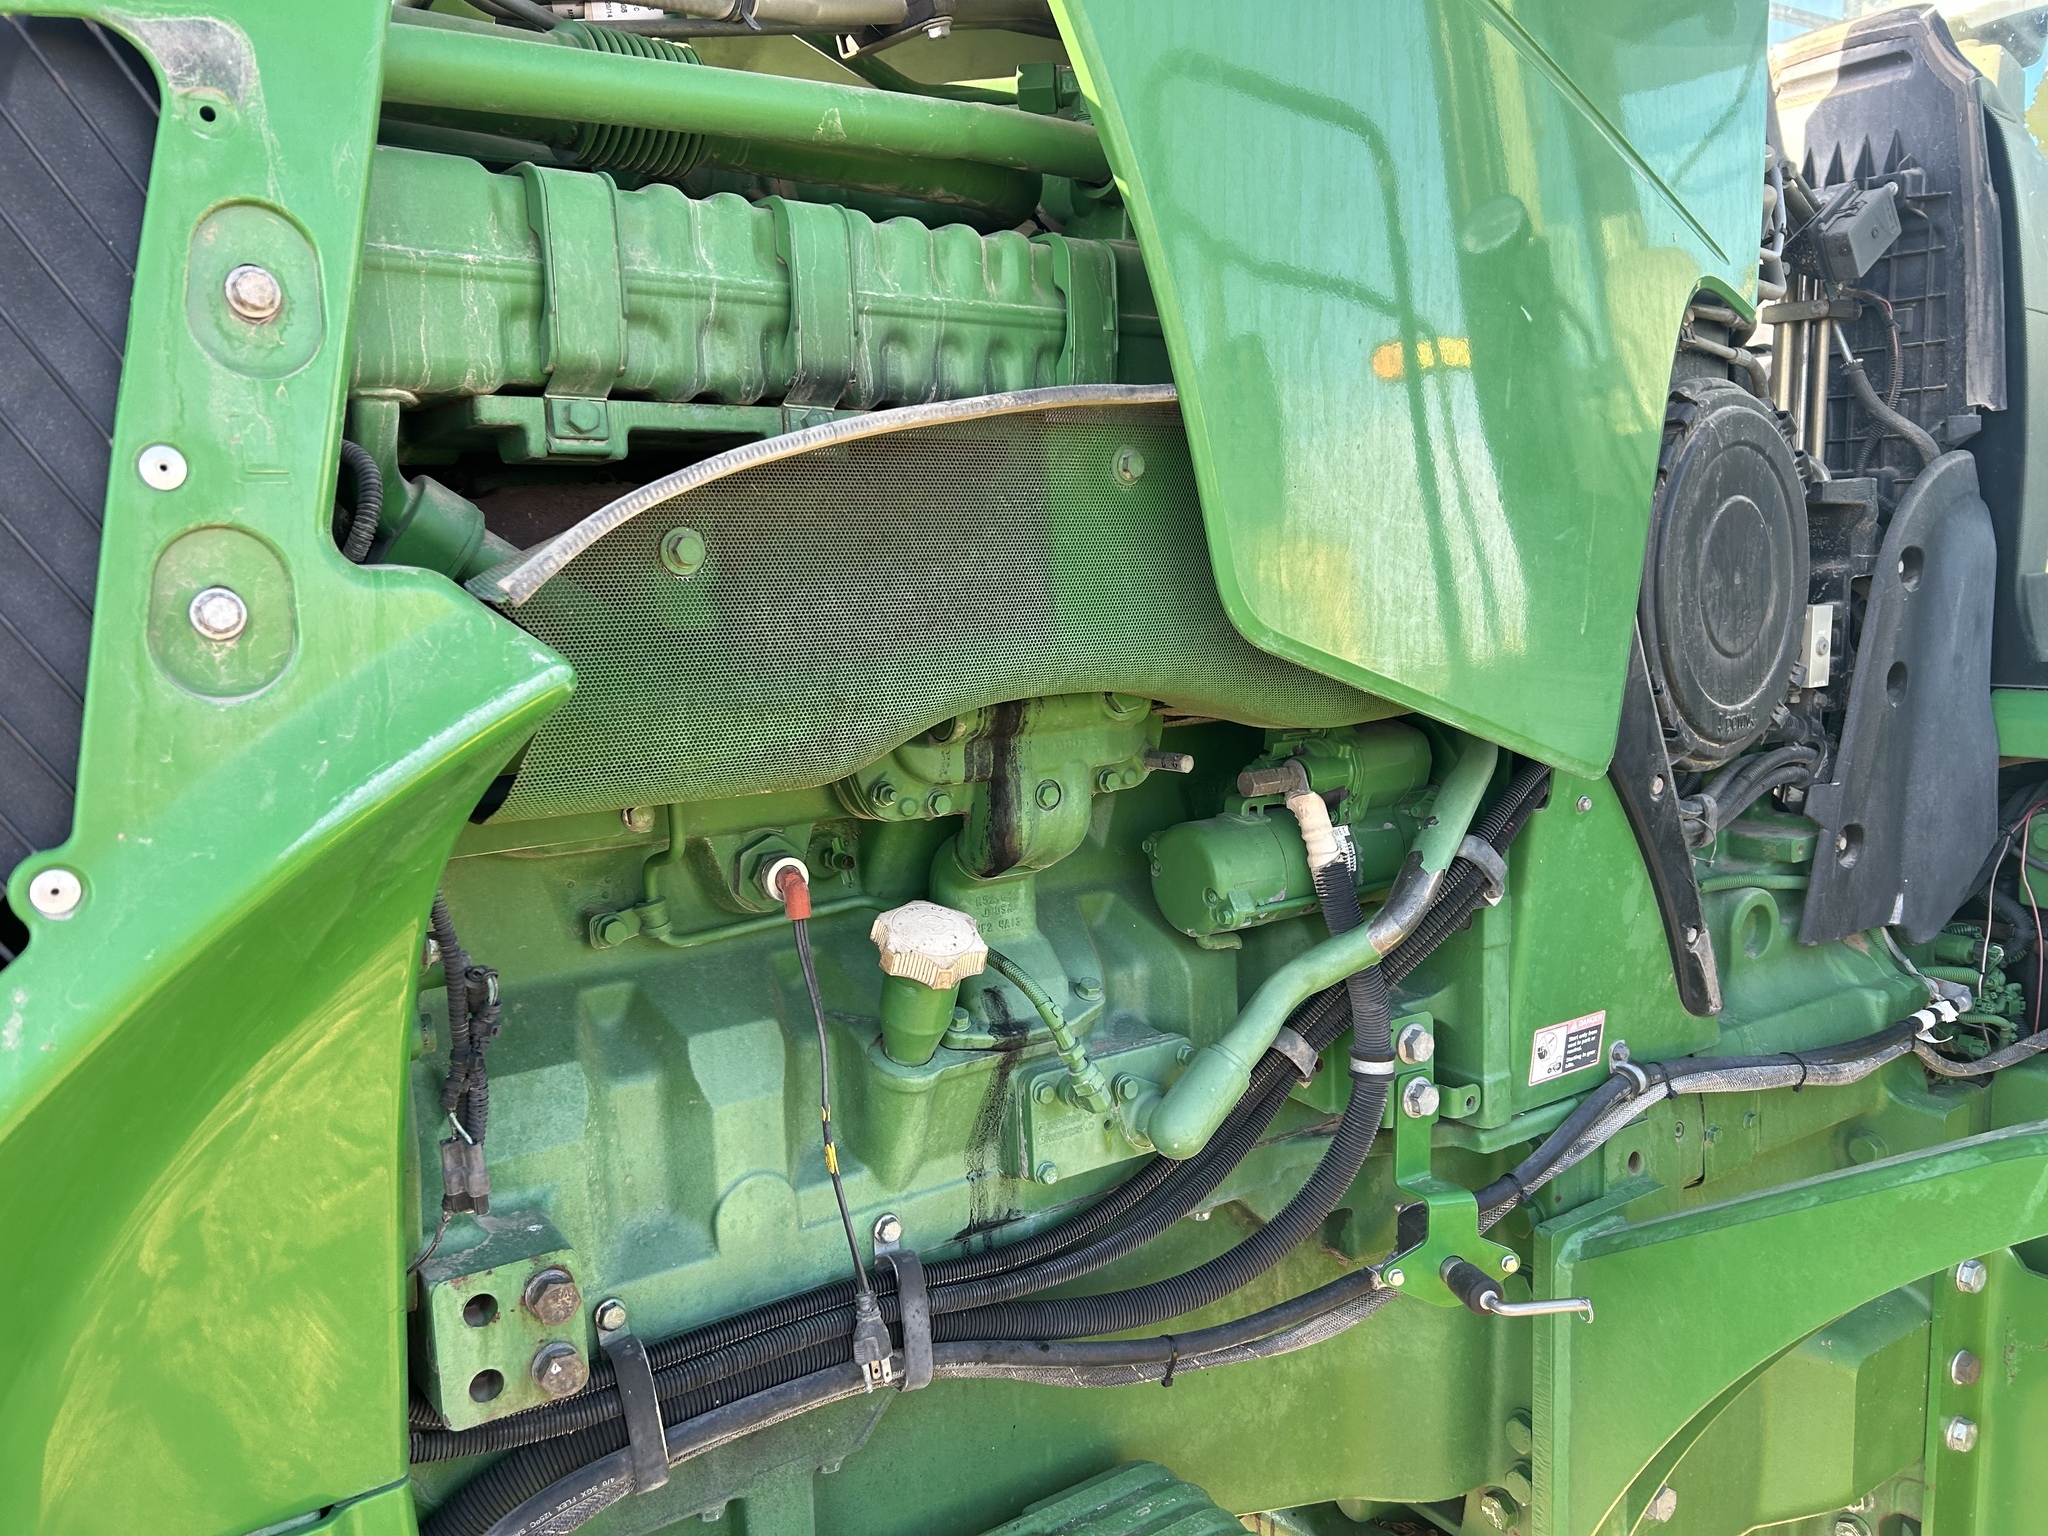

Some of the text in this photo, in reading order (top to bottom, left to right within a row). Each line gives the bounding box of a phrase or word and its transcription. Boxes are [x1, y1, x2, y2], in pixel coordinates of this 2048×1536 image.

[1579, 1014, 1602, 1025] DANGER
[602, 1477, 615, 1487] 4/0
[580, 1485, 598, 1499] SGX
[555, 1496, 577, 1512] FLEX
